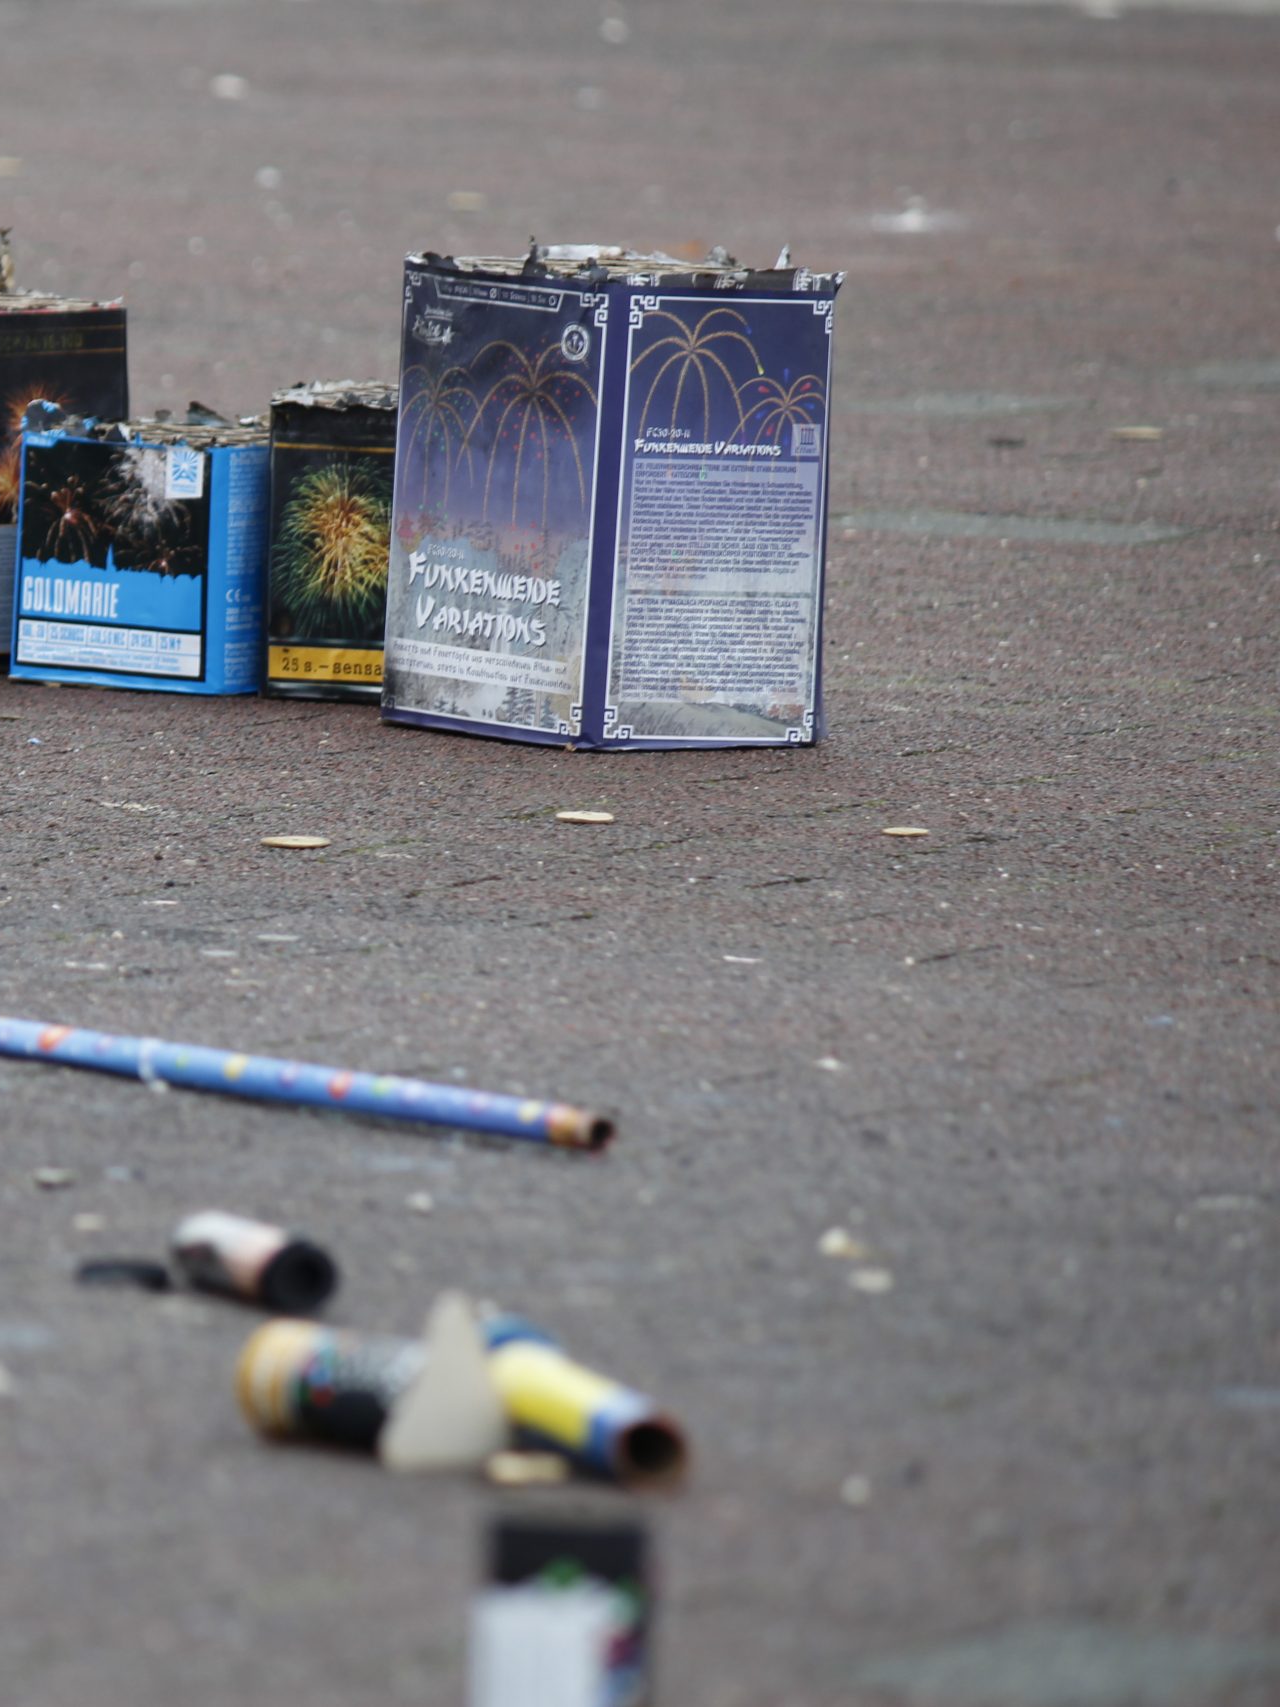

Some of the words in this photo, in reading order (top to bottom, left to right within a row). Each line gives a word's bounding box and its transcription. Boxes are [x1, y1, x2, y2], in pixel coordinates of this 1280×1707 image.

[634, 438, 712, 455] FUNKENWEIDE
[714, 441, 782, 456] VARIATIONS
[22, 576, 120, 619] GOLDMARIE
[408, 551, 562, 607] FUNKENWEIDE
[415, 594, 547, 647] VARIATIONS
[281, 657, 299, 672] 25
[332, 662, 383, 676] sensa
